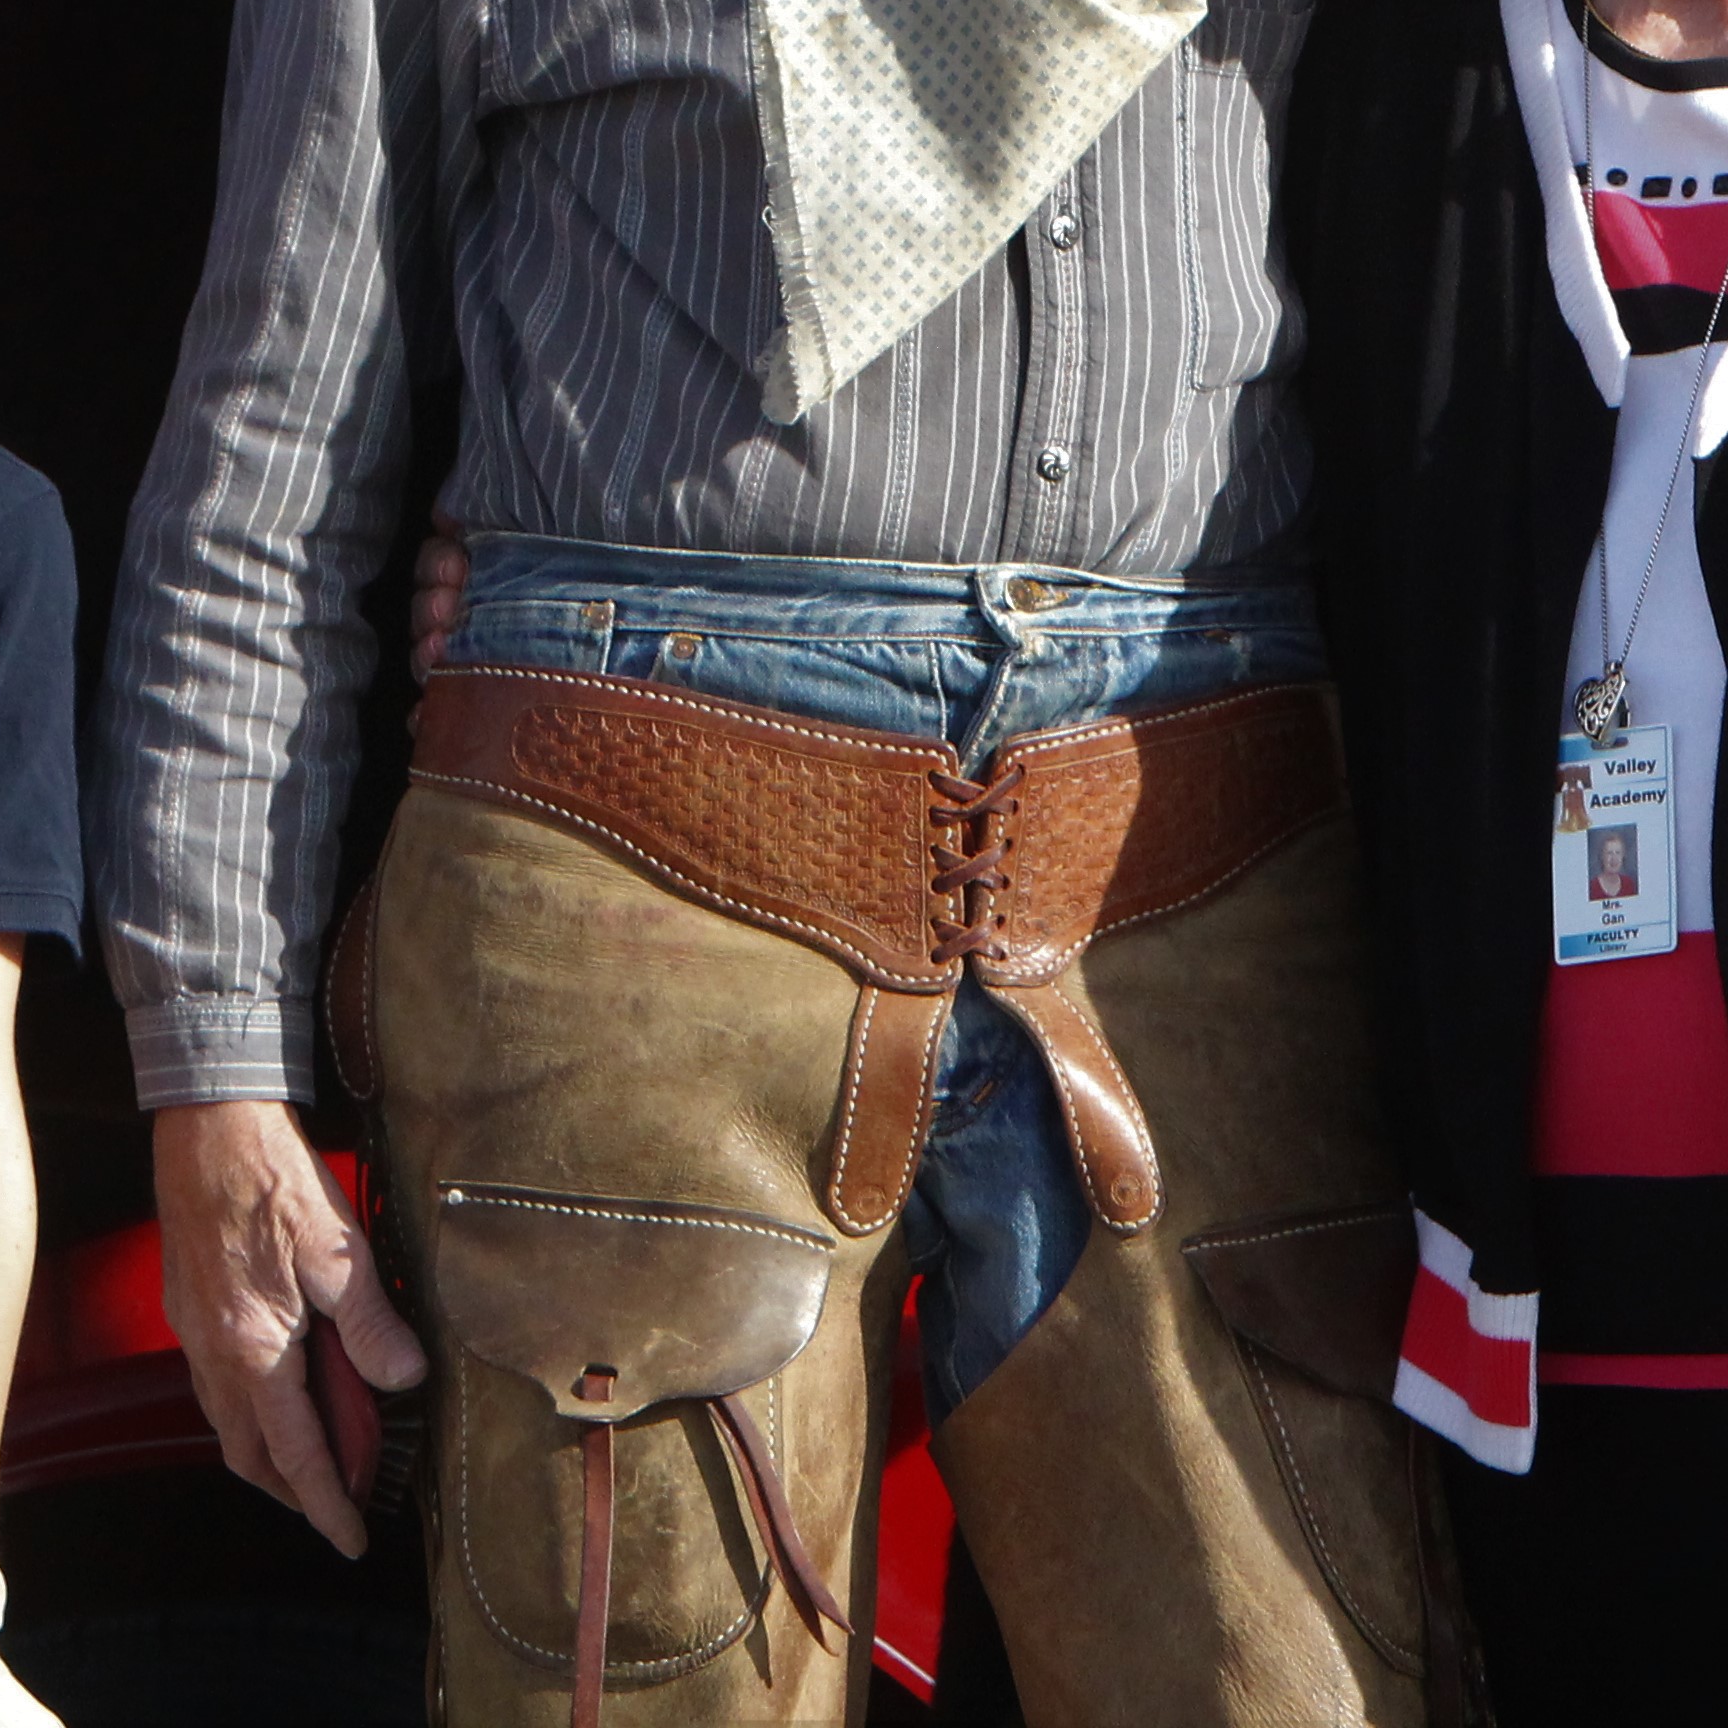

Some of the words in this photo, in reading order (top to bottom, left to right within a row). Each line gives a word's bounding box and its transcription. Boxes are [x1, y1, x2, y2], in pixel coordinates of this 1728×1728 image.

[1604, 758, 1657, 776] Valley
[1590, 787, 1667, 809] Academy
[1587, 928, 1639, 944] FACULTY
